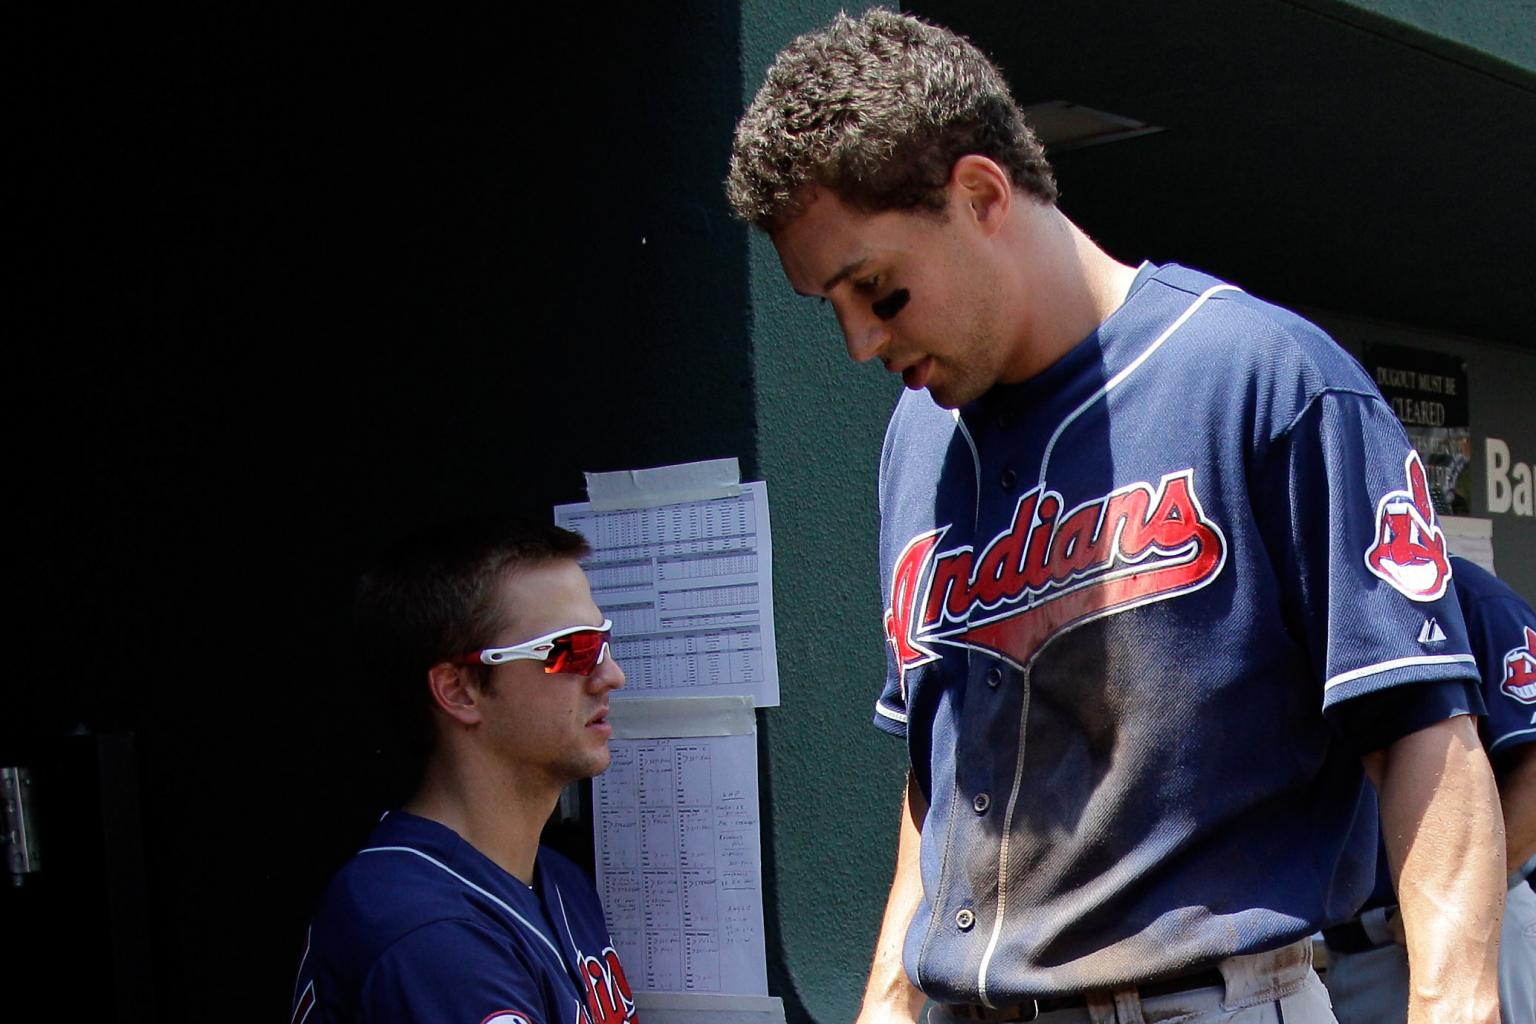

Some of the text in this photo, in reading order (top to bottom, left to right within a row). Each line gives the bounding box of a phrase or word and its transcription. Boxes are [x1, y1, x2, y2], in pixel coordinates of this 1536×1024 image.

[1376, 367, 1457, 395] DUGOUT MUST BE
[1392, 397, 1446, 426] CLEARED
[884, 468, 1227, 670] Indians
